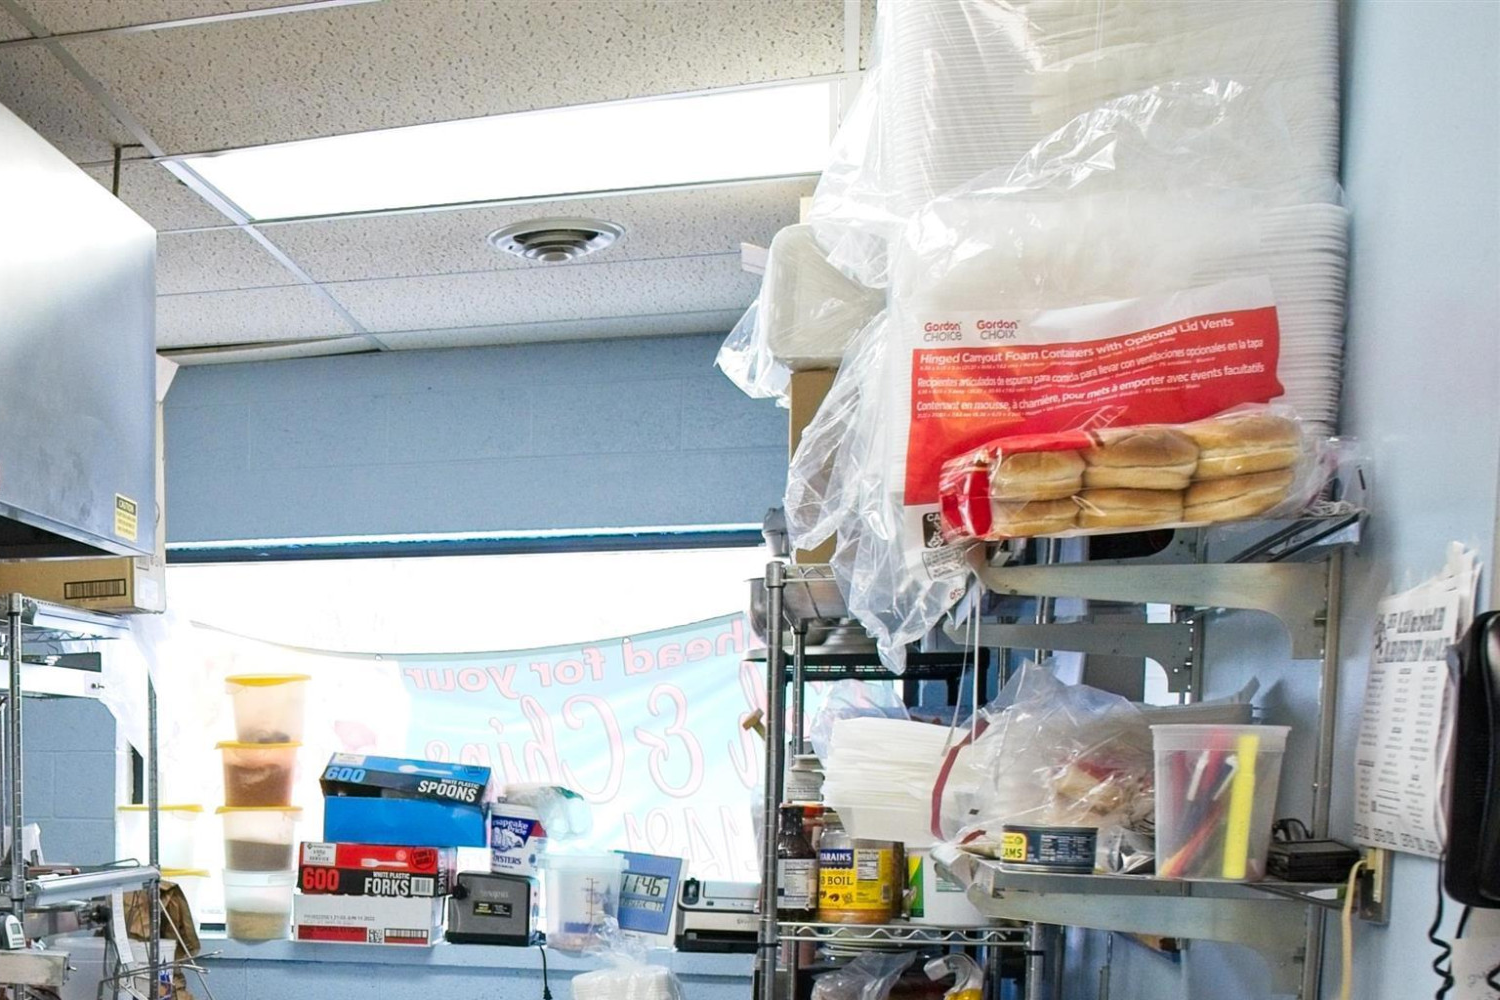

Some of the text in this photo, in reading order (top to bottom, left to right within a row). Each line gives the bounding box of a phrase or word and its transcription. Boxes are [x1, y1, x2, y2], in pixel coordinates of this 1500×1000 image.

[924, 322, 961, 332] Gordon
[976, 319, 1018, 330] Gordon
[920, 317, 1235, 365] Hinged Carryout Foam Containers with Optional Lid Vents
[980, 329, 1016, 340] CHOIX
[959, 376, 996, 386] articulados
[1005, 377, 1033, 388] espuma
[1034, 375, 1050, 387] para
[1052, 372, 1079, 383] comida
[1080, 369, 1097, 380] para
[1098, 362, 1118, 374] llevar
[1120, 359, 1135, 370] con
[1136, 349, 1185, 366] ventilaciones
[1186, 343, 1227, 358] opcionales
[1227, 341, 1237, 350] en
[1238, 340, 1246, 349] la
[1247, 339, 1263, 350] tapa
[916, 401, 959, 411] Contenant
[961, 402, 972, 411] en
[974, 401, 1011, 411] mousse,
[1062, 392, 1086, 402] pour
[1086, 387, 1110, 399] mets
[1111, 383, 1118, 392] à
[1119, 375, 1165, 391] emporter
[1166, 373, 1189, 384] avec
[1224, 361, 1265, 376] facultatifs
[325, 766, 366, 783] 600
[418, 780, 477, 803] SPOONS
[458, 780, 480, 789] PLASTIC
[303, 867, 339, 890] 600
[389, 872, 410, 880] PLASTIC
[827, 876, 854, 885] BOIL
[364, 877, 410, 896] FORKS
[622, 875, 661, 897] 11:46
